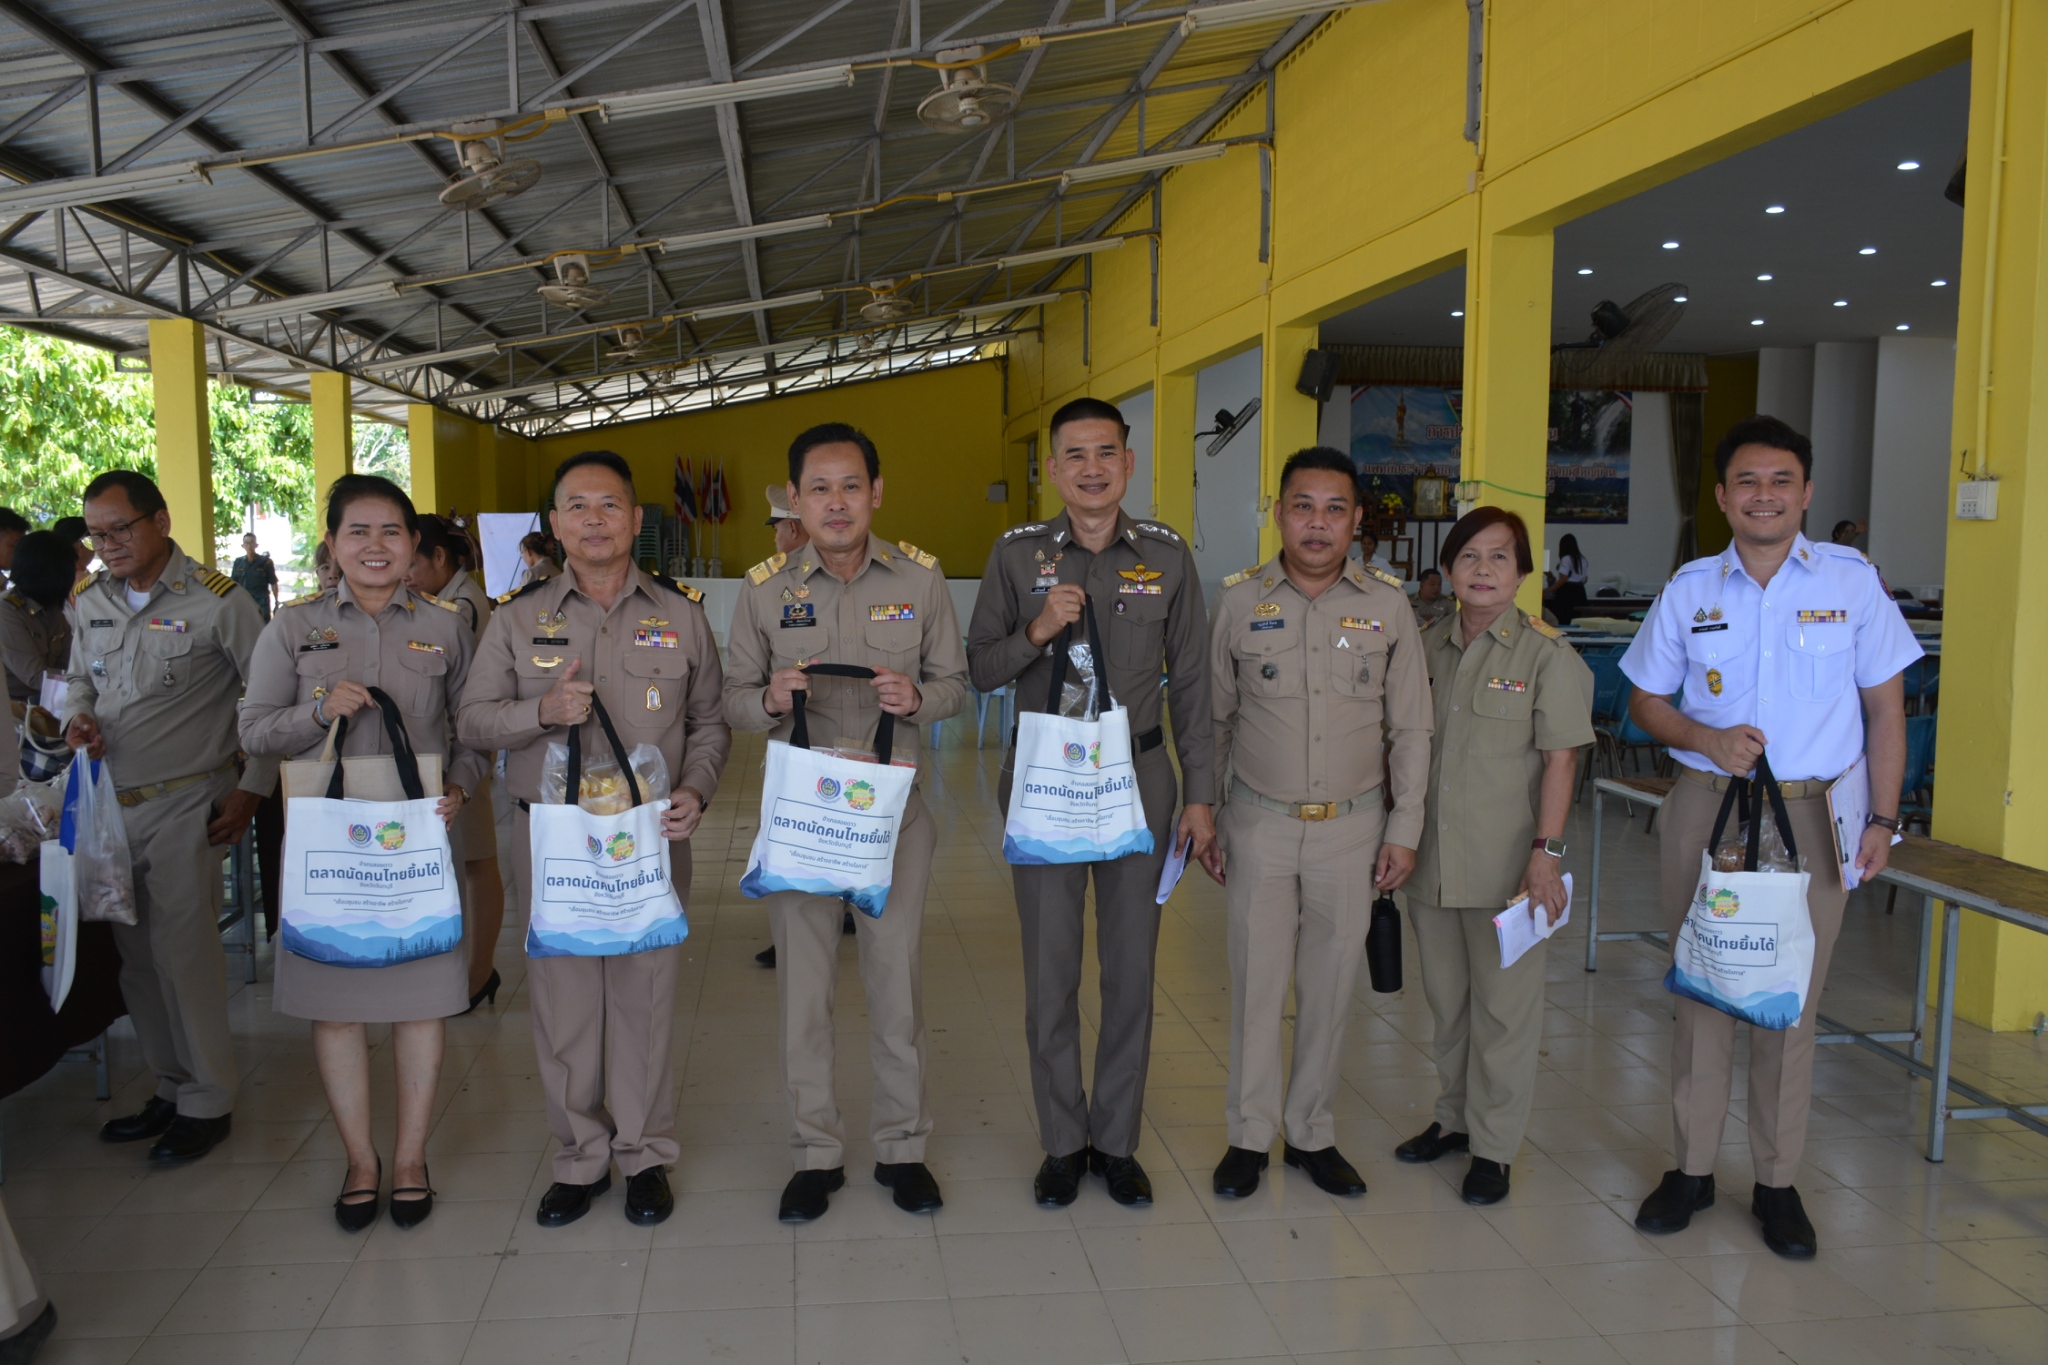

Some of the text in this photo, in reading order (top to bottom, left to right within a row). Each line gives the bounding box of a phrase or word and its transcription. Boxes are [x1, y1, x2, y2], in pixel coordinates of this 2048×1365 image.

[773, 815, 891, 844] ตลาดนัดคนไทยยิ้มได้
[309, 862, 441, 883] ตลาดนัดคนไทยยิ้มได้
